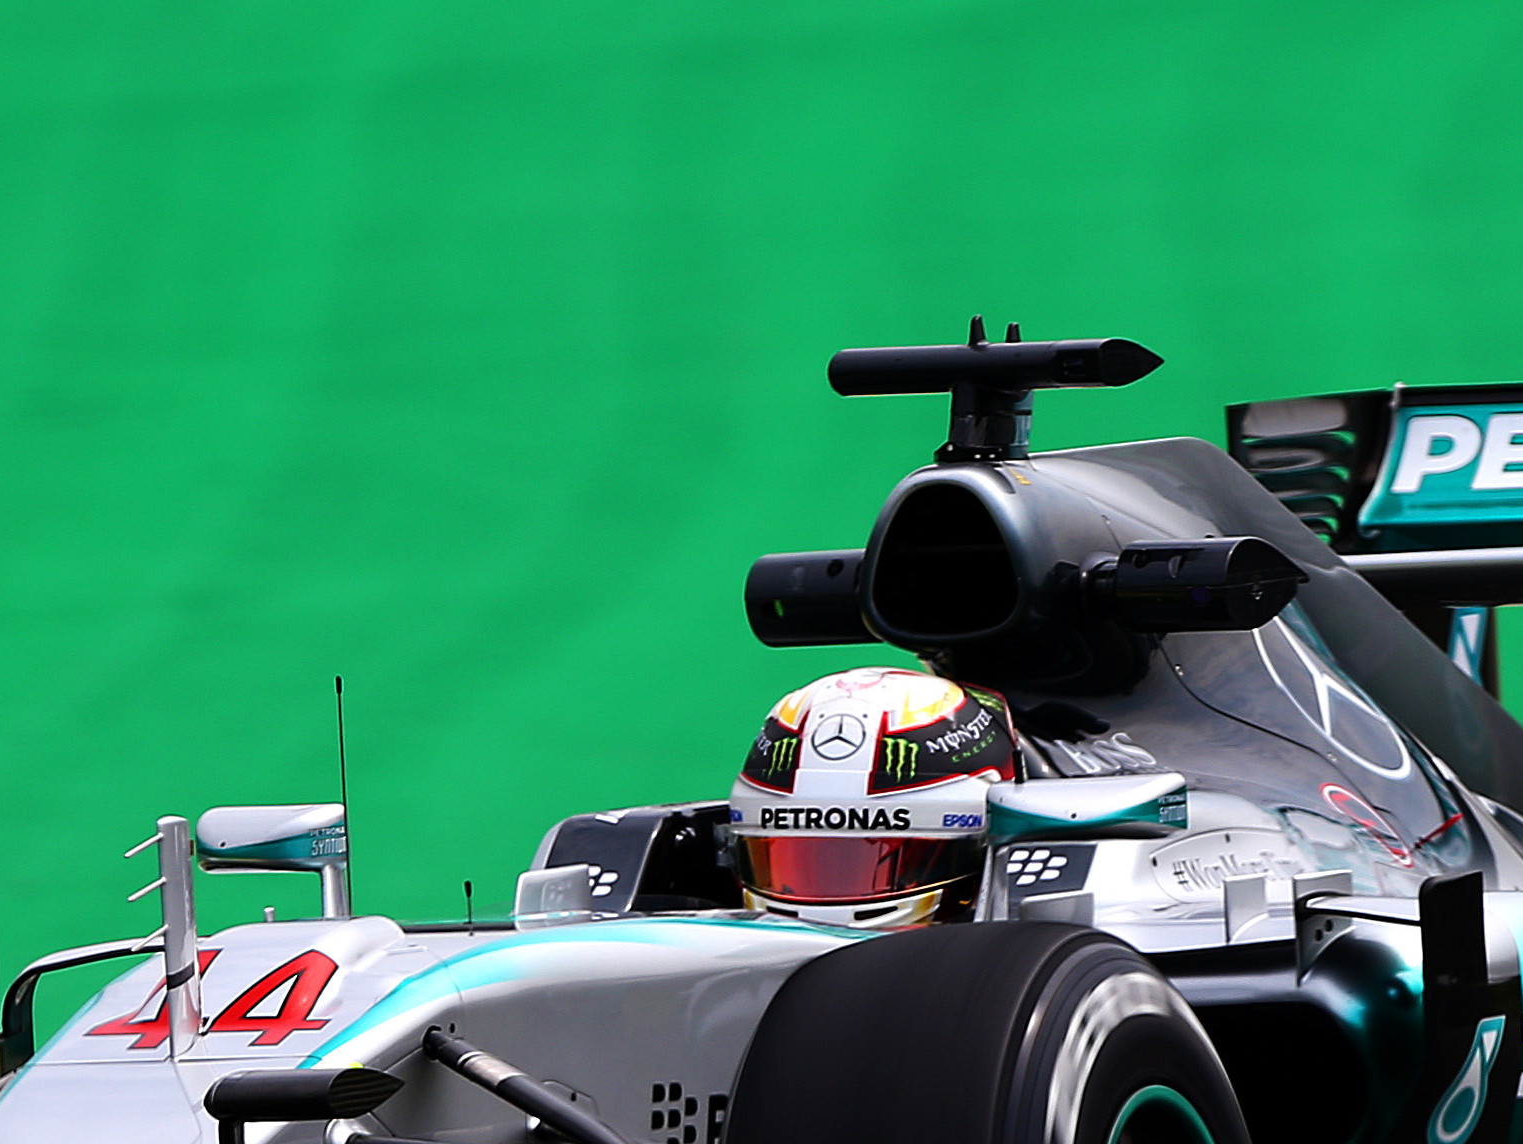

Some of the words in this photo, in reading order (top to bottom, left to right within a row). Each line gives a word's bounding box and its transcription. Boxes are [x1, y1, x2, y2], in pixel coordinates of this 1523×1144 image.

[761, 807, 911, 831] PETRONAS
[943, 814, 983, 828] EPSON
[82, 948, 340, 1051] 44
